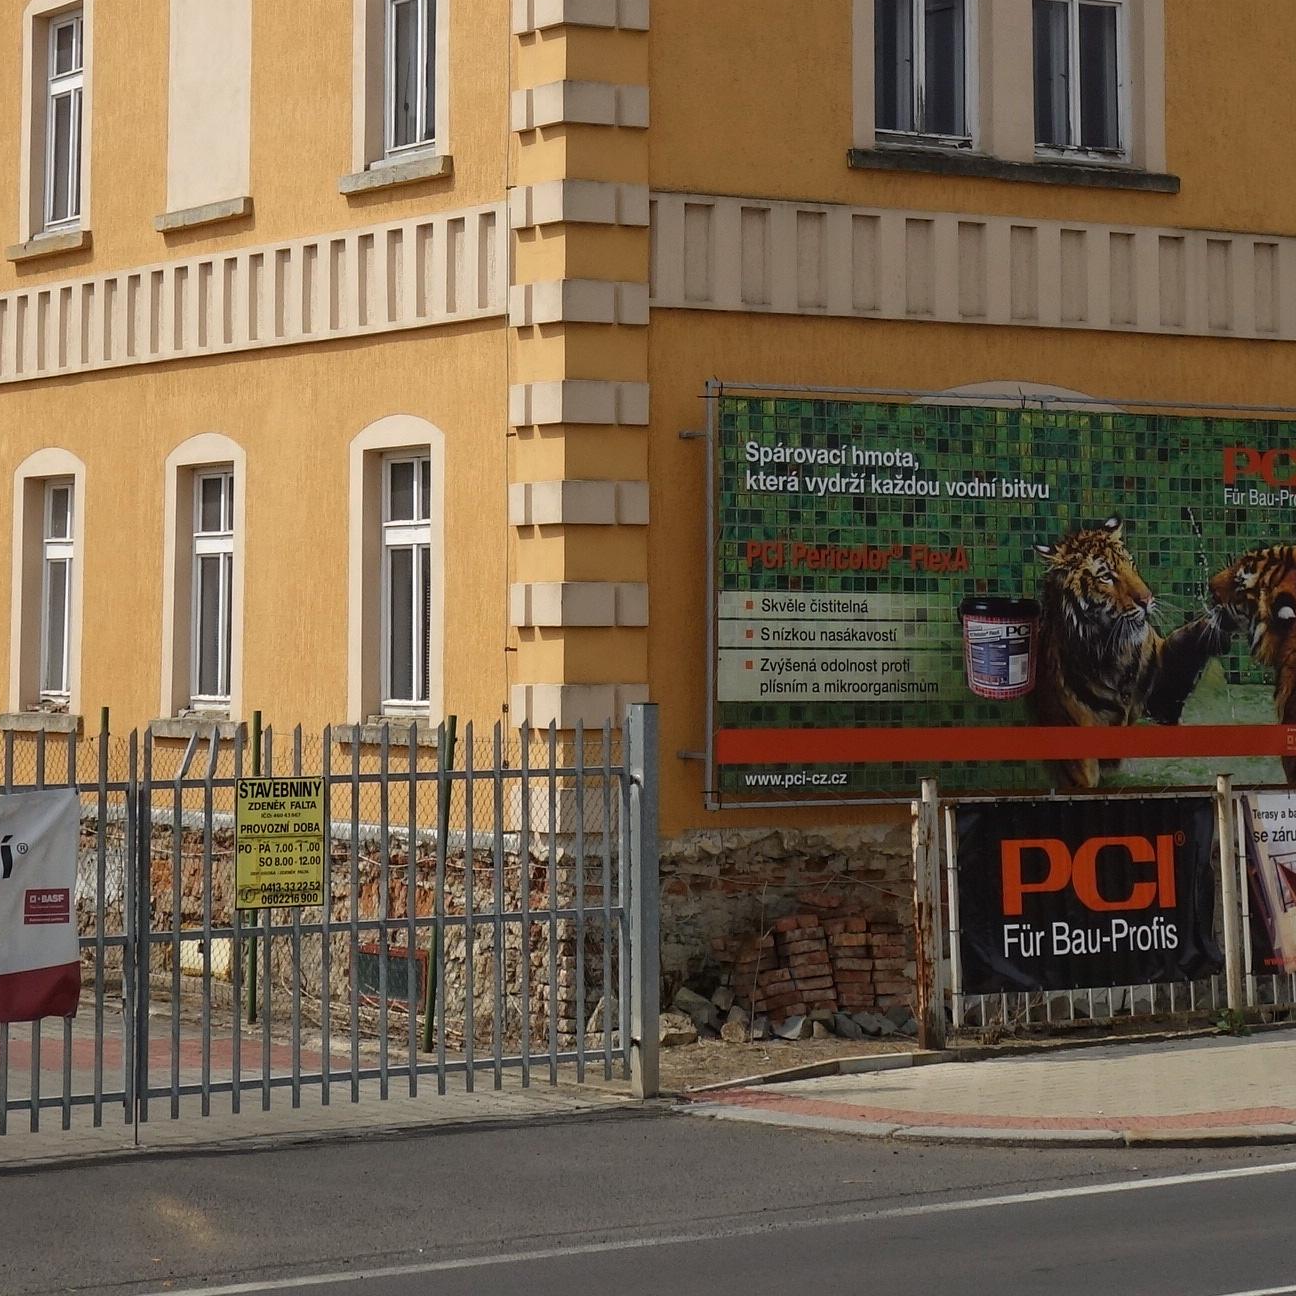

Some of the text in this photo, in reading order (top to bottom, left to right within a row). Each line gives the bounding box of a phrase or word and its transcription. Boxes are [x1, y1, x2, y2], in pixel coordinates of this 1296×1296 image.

[745, 440, 919, 470] Spárovací hmota,
[746, 470, 1050, 500] která vydrží každou vodní bitvu
[1224, 488, 1245, 505] Für
[746, 542, 785, 570] PCI
[910, 545, 969, 572] FlexA
[761, 598, 869, 614] Skvěle čistitelná
[761, 627, 897, 642] S nízkou nasákavostí
[760, 657, 910, 675] Zvýšená odolnost proti
[760, 679, 808, 696] plísním
[812, 683, 820, 693] a
[745, 772, 847, 789] www.pci-cz.cz
[239, 781, 321, 798] STAVEBNINY
[248, 800, 317, 811] ZDENĚK FALTA
[1252, 809, 1279, 821] Terasy
[1281, 811, 1286, 819] a
[241, 821, 320, 834] PROVOZNÍ DOBA
[1253, 831, 1268, 842] se
[239, 844, 252, 854] PO
[259, 857, 272, 866] SO
[299, 856, 321, 865] 12.00
[42, 894, 64, 902] BASF
[1004, 916, 1178, 958] Für Bau-Profis
